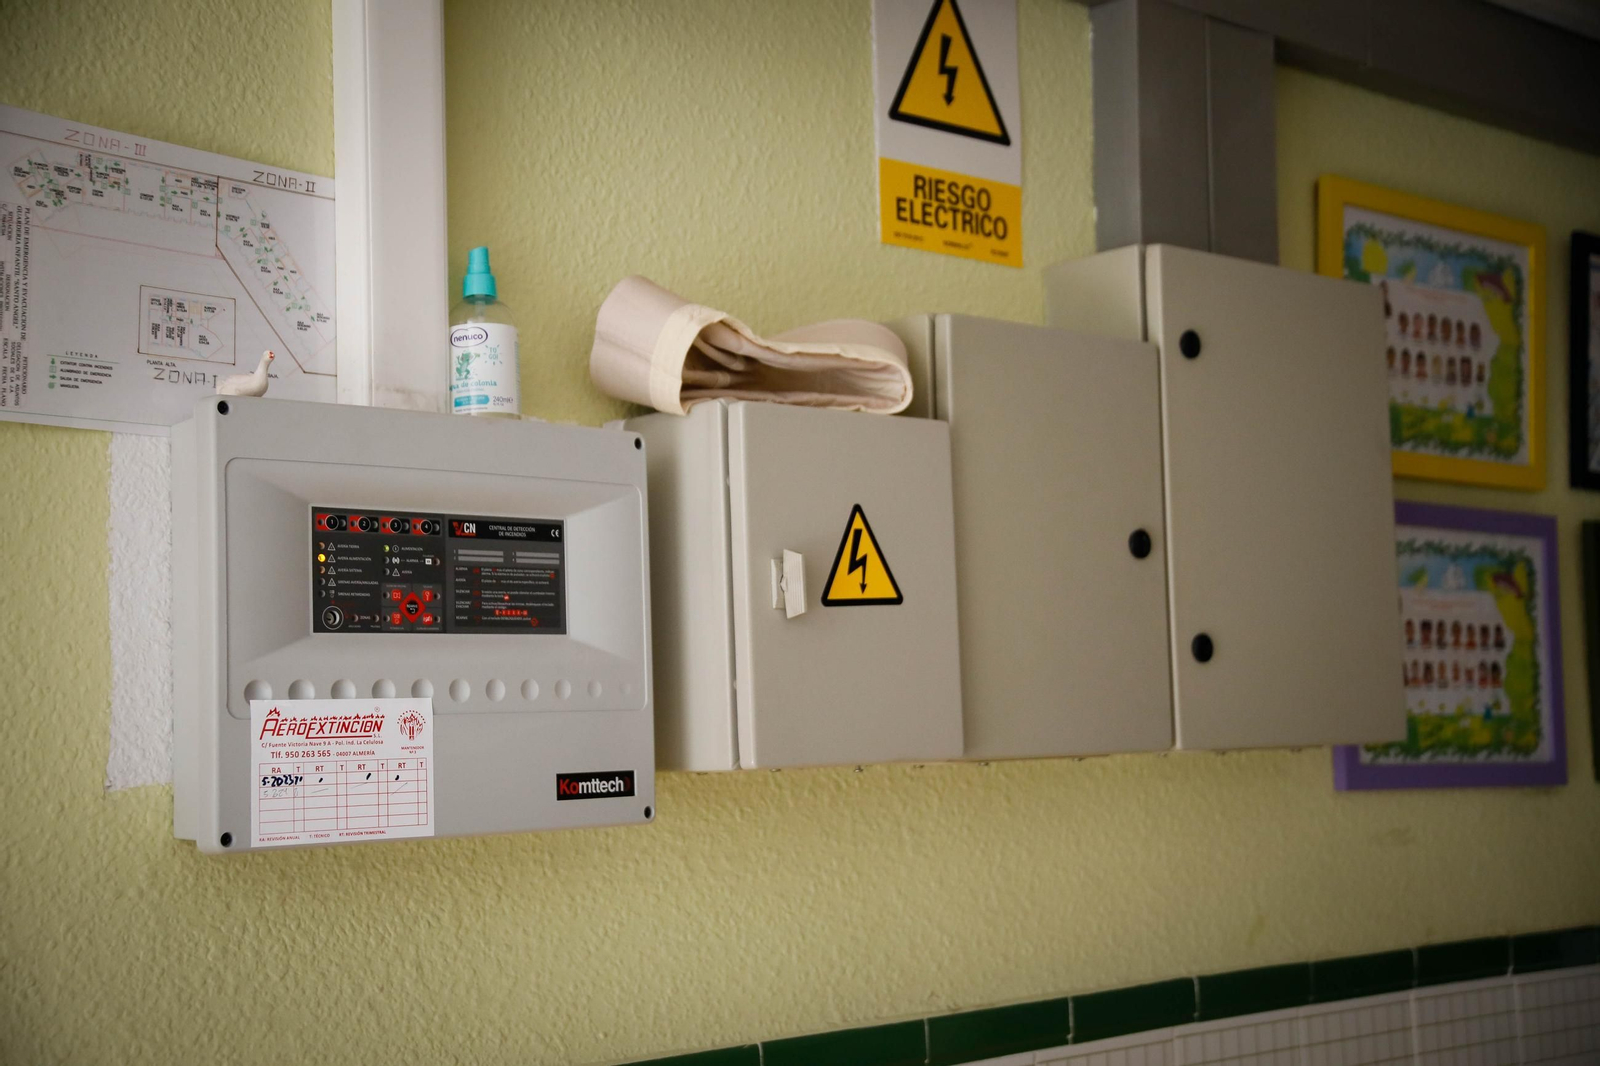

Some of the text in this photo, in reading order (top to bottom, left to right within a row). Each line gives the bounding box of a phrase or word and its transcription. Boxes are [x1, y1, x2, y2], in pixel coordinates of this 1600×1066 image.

[914, 174, 992, 212] RIESGO
[896, 197, 1007, 240] ELECTRICO
[21, 332, 26, 340] DE
[454, 333, 483, 342] nenuco
[560, 776, 624, 795] Komttech
